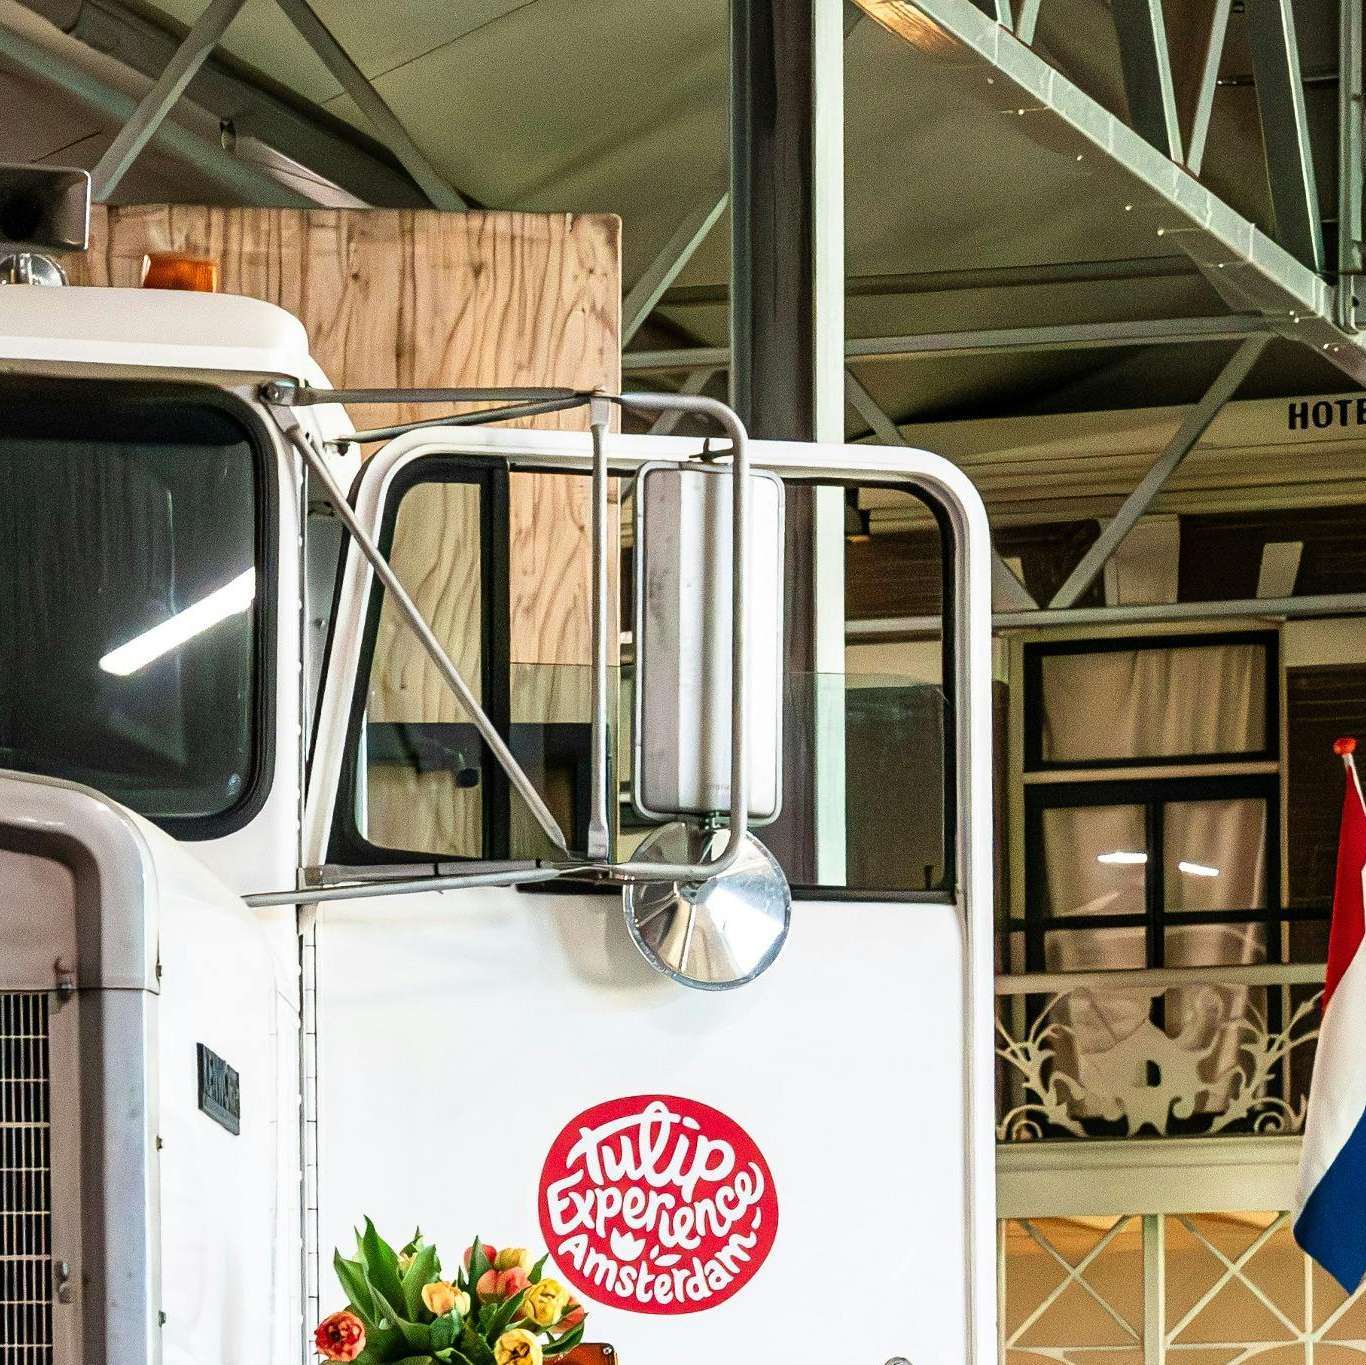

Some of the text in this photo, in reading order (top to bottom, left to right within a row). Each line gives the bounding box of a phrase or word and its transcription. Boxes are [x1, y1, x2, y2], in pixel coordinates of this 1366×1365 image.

[566, 1100, 735, 1203] Tulip
[547, 1162, 765, 1250] Experience
[558, 1232, 757, 1304] Amsterdam
